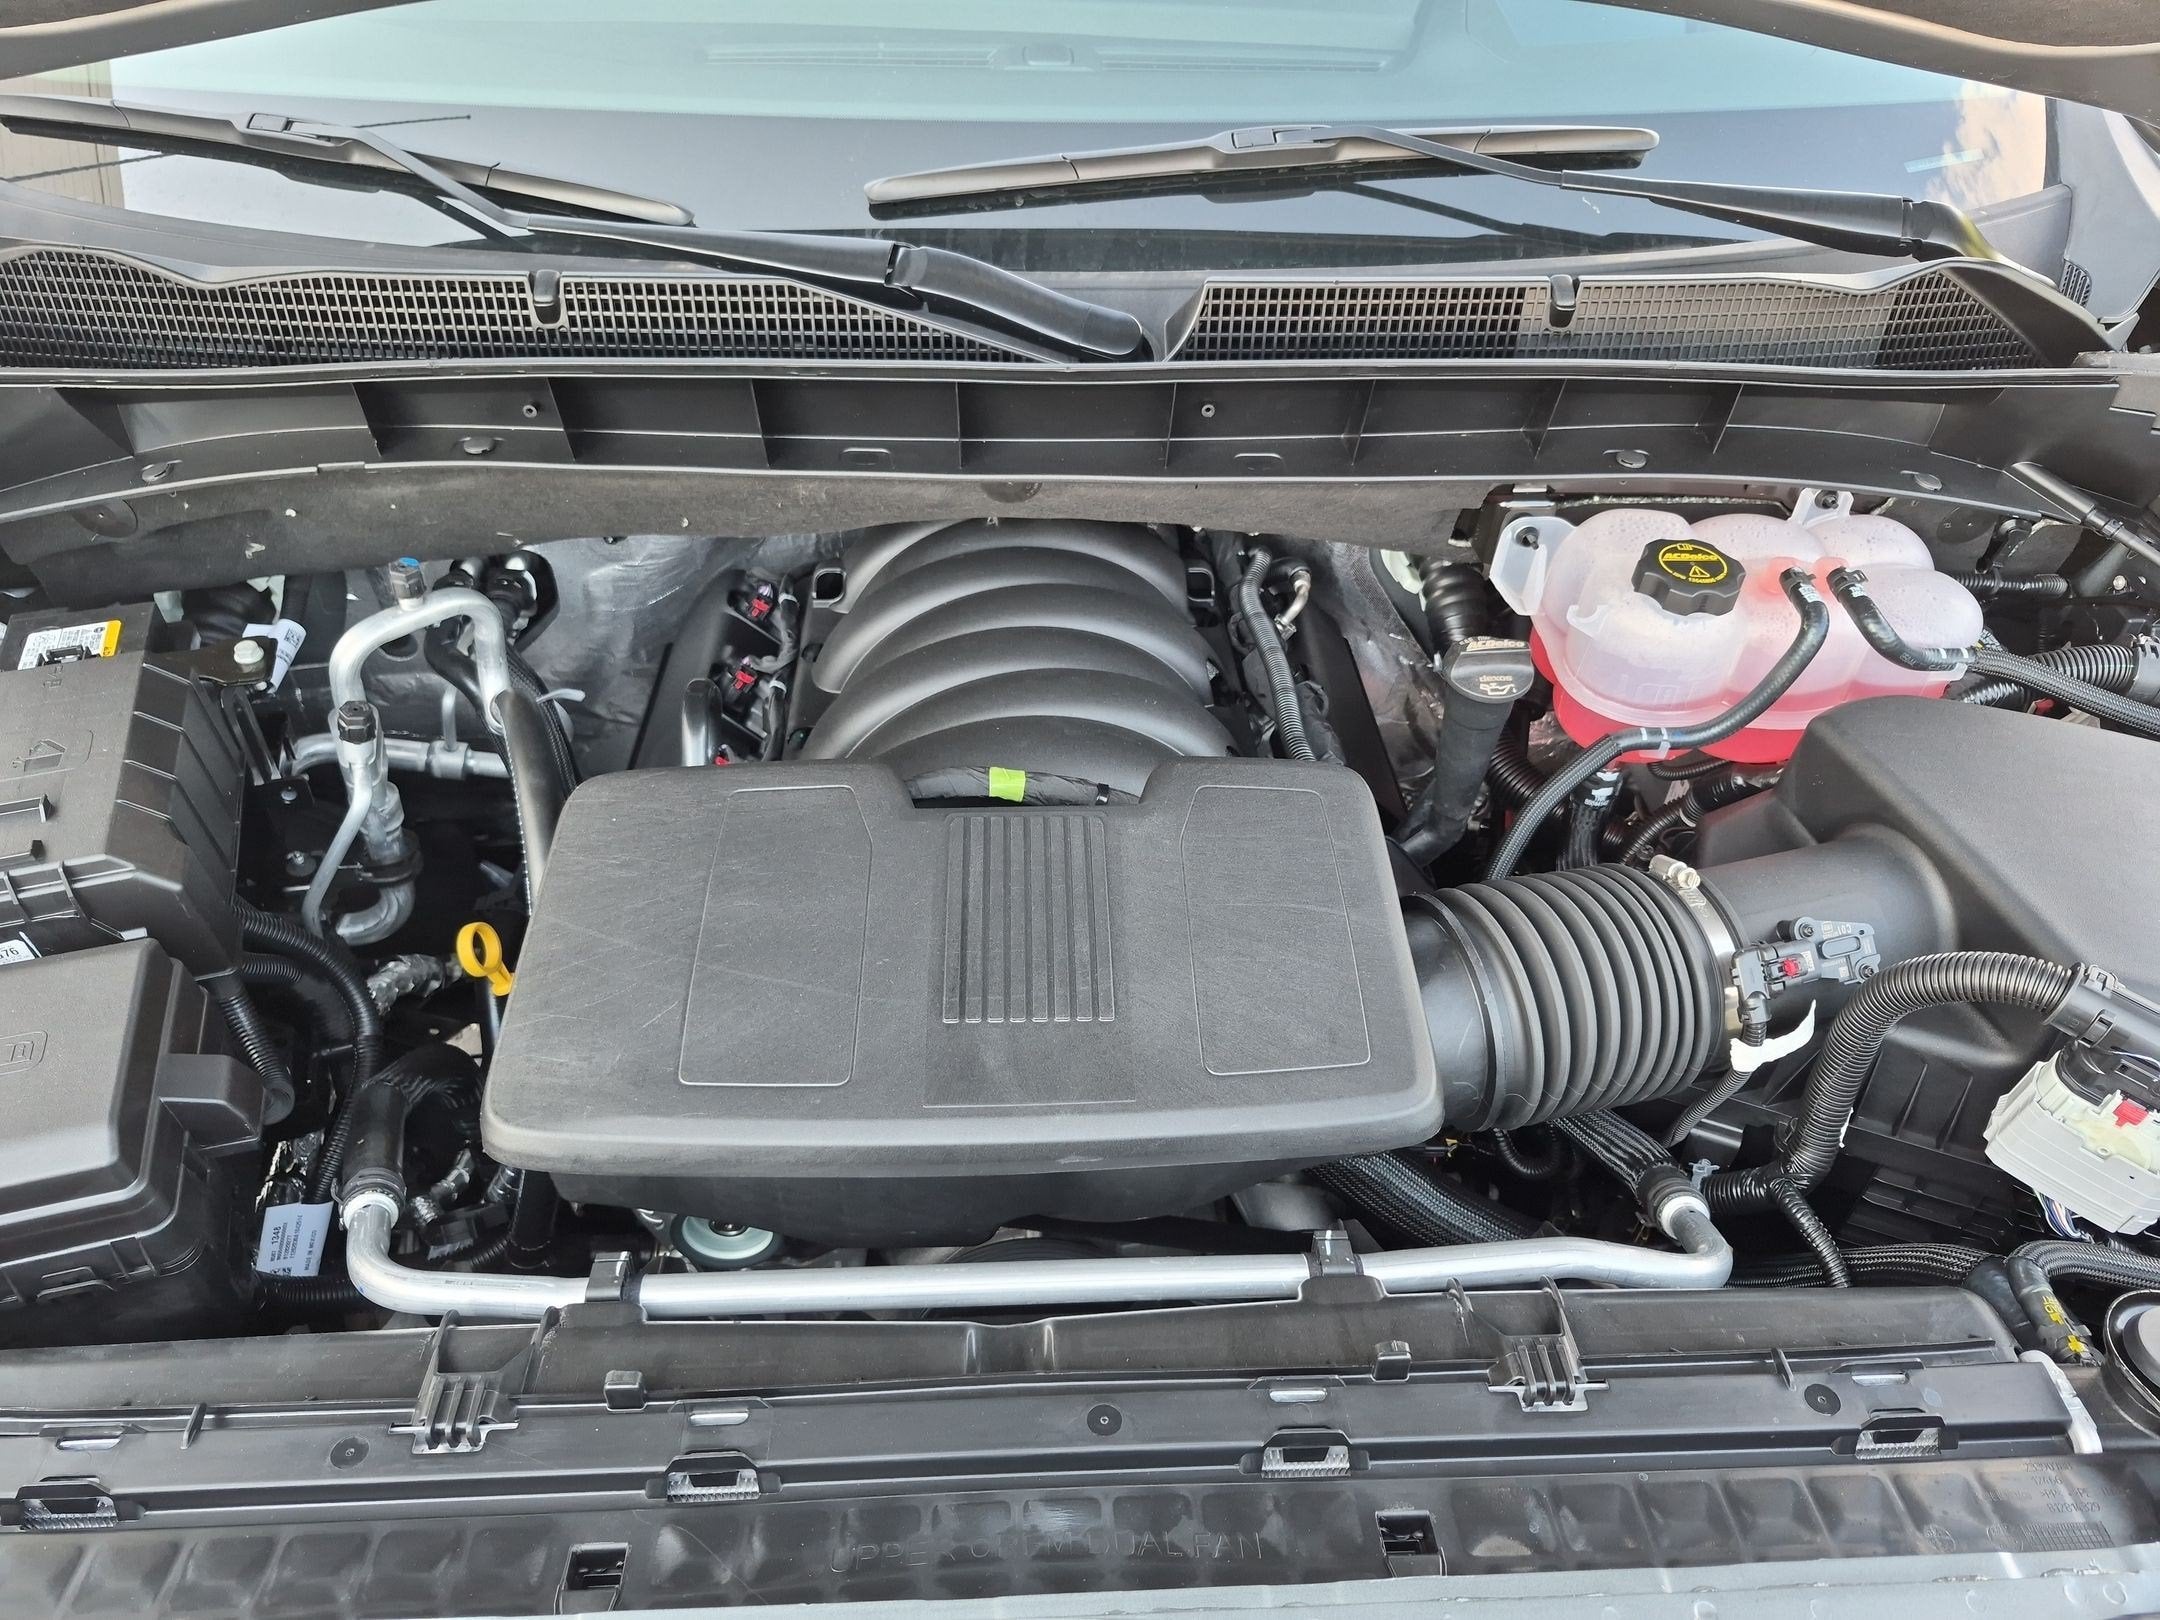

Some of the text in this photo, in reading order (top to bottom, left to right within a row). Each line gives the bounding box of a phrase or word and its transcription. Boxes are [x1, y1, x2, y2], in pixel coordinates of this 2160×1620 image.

[1663, 552, 1718, 561] ACDelco
[1467, 639, 1525, 650] ACDelco
[0, 947, 20, 960] 76
[304, 1257, 312, 1271] MADE
[309, 1229, 317, 1249] MEXICO
[831, 1540, 956, 1573] UPPER
[1088, 1530, 1183, 1558] DUAL
[1194, 1531, 1262, 1560] FAN
